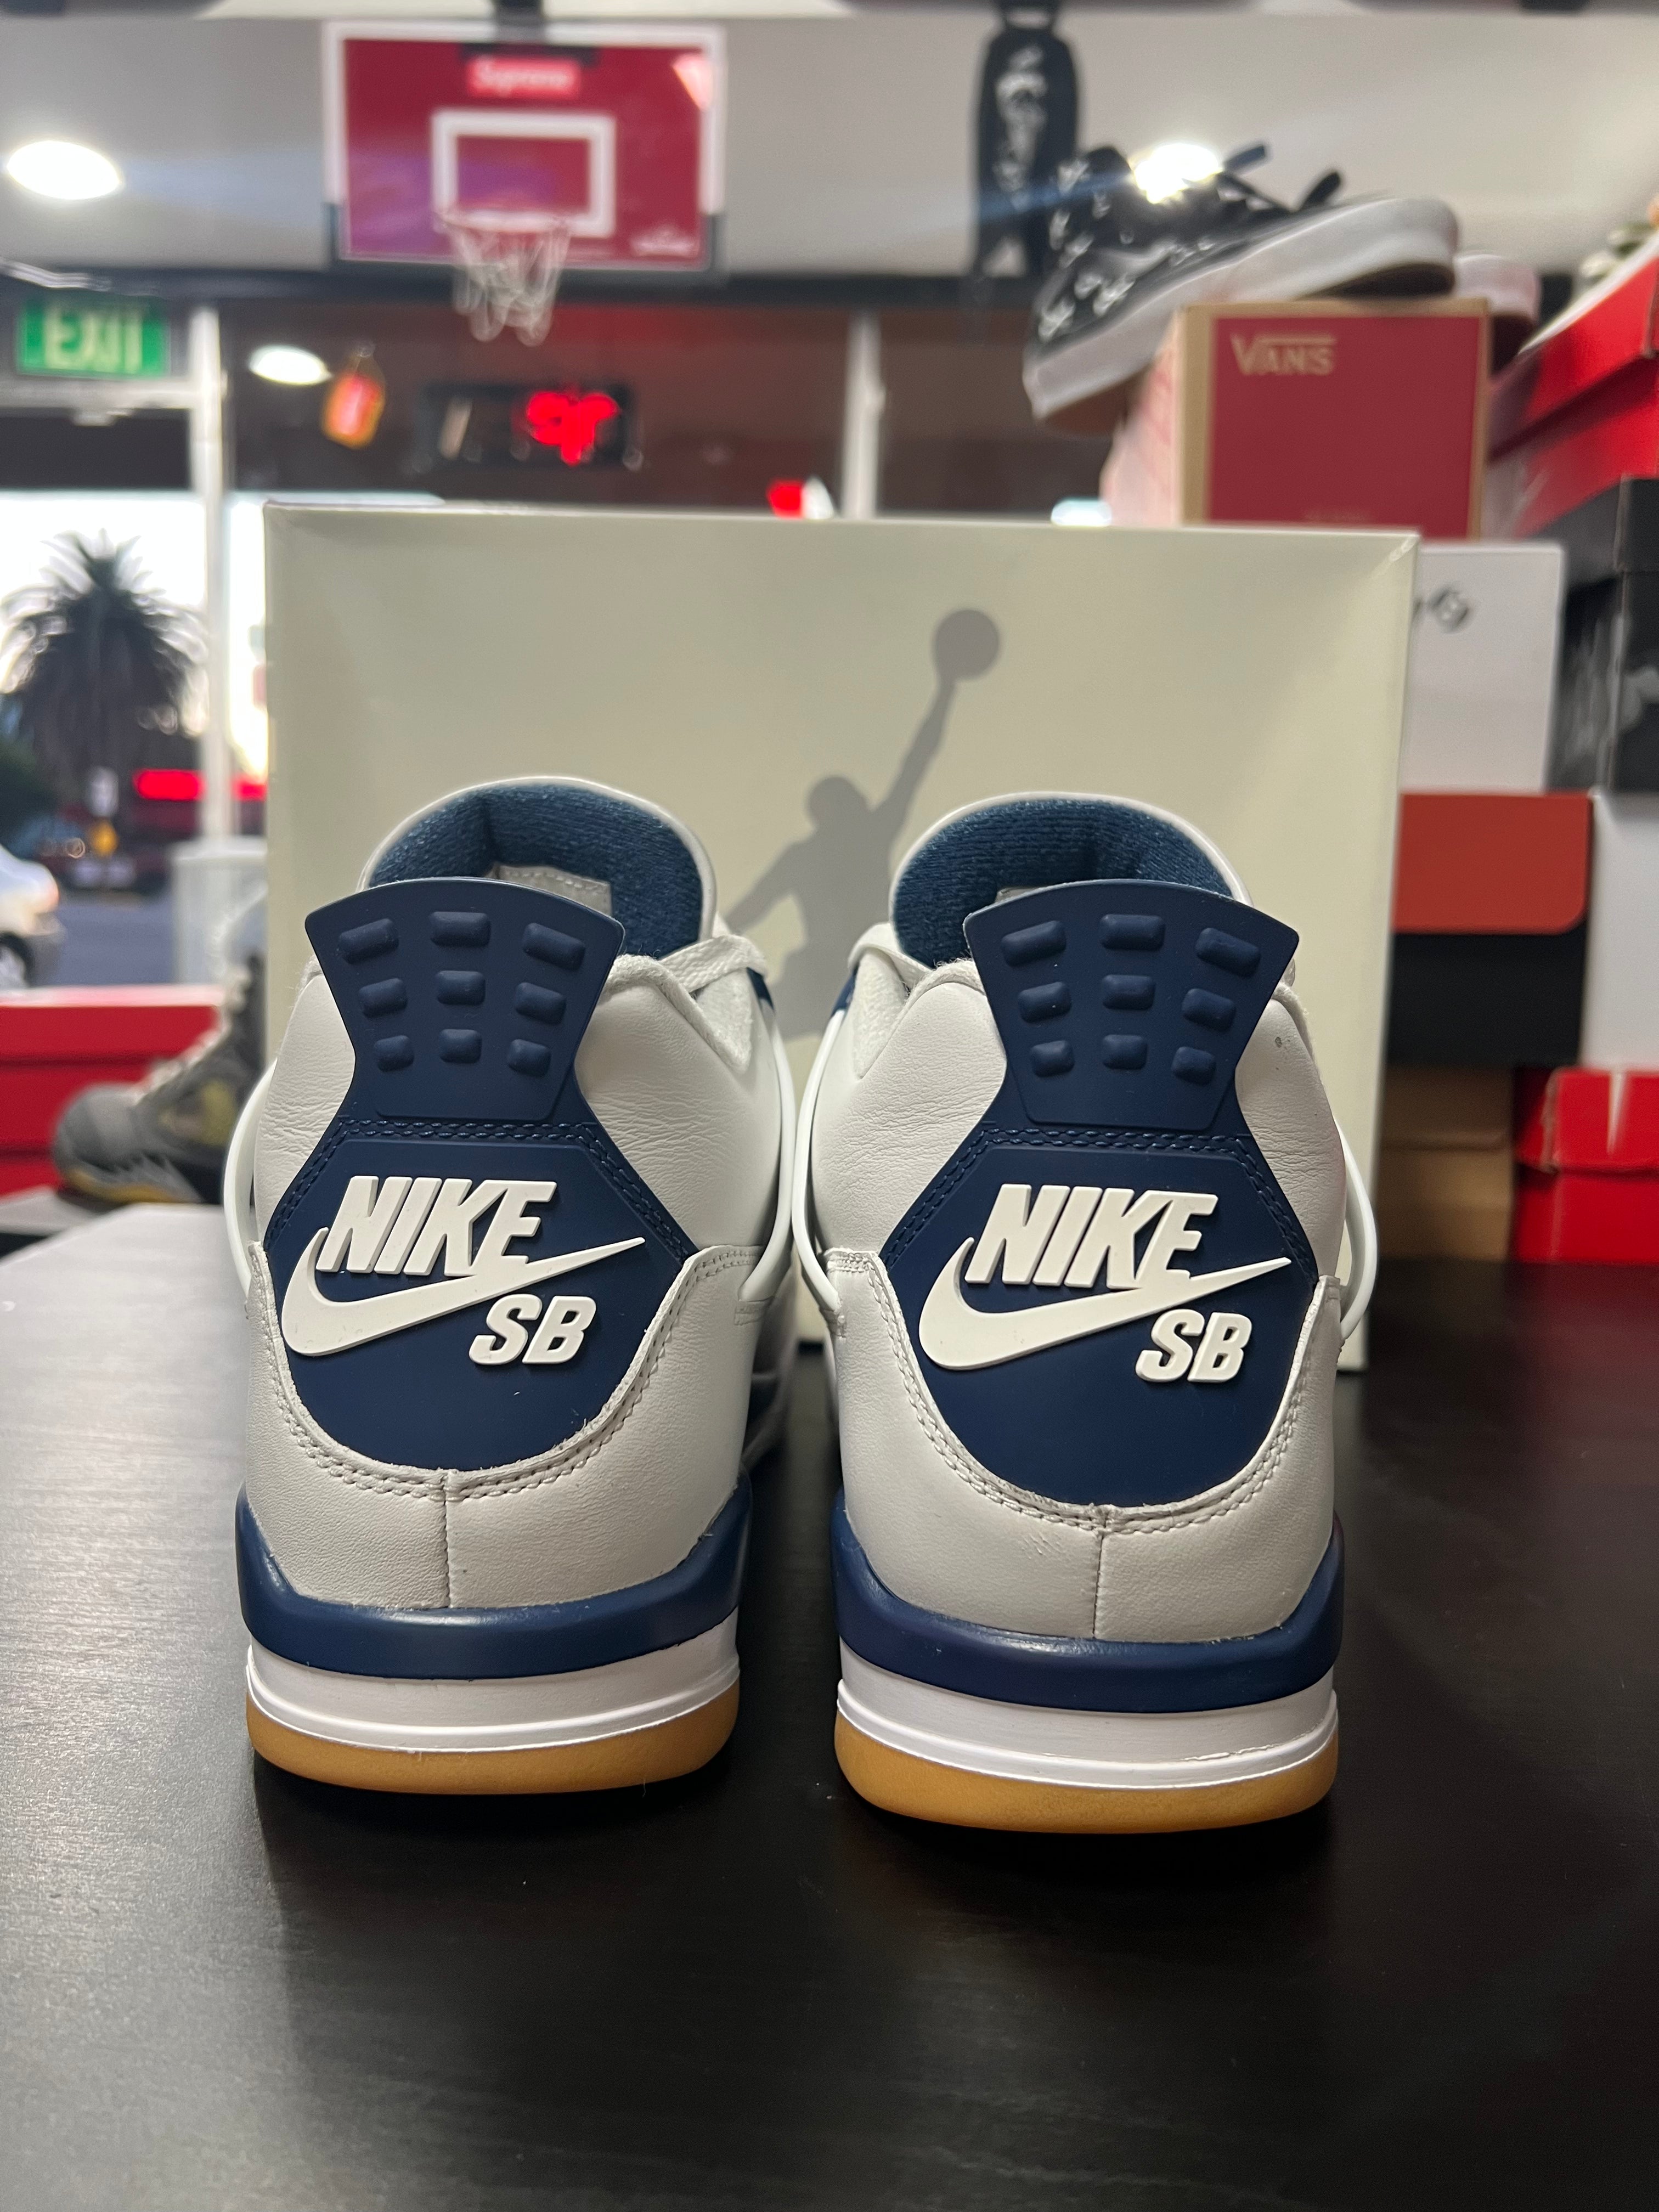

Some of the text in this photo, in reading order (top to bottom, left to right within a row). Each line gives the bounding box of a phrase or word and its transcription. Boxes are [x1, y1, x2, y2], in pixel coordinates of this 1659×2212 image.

[44, 303, 143, 374] EXIT
[1231, 332, 1337, 376] VANS
[315, 1176, 557, 1276] NIKE
[964, 1183, 1218, 1289] NIKE
[469, 1293, 597, 1364] SB
[1135, 1308, 1252, 1383] SB
